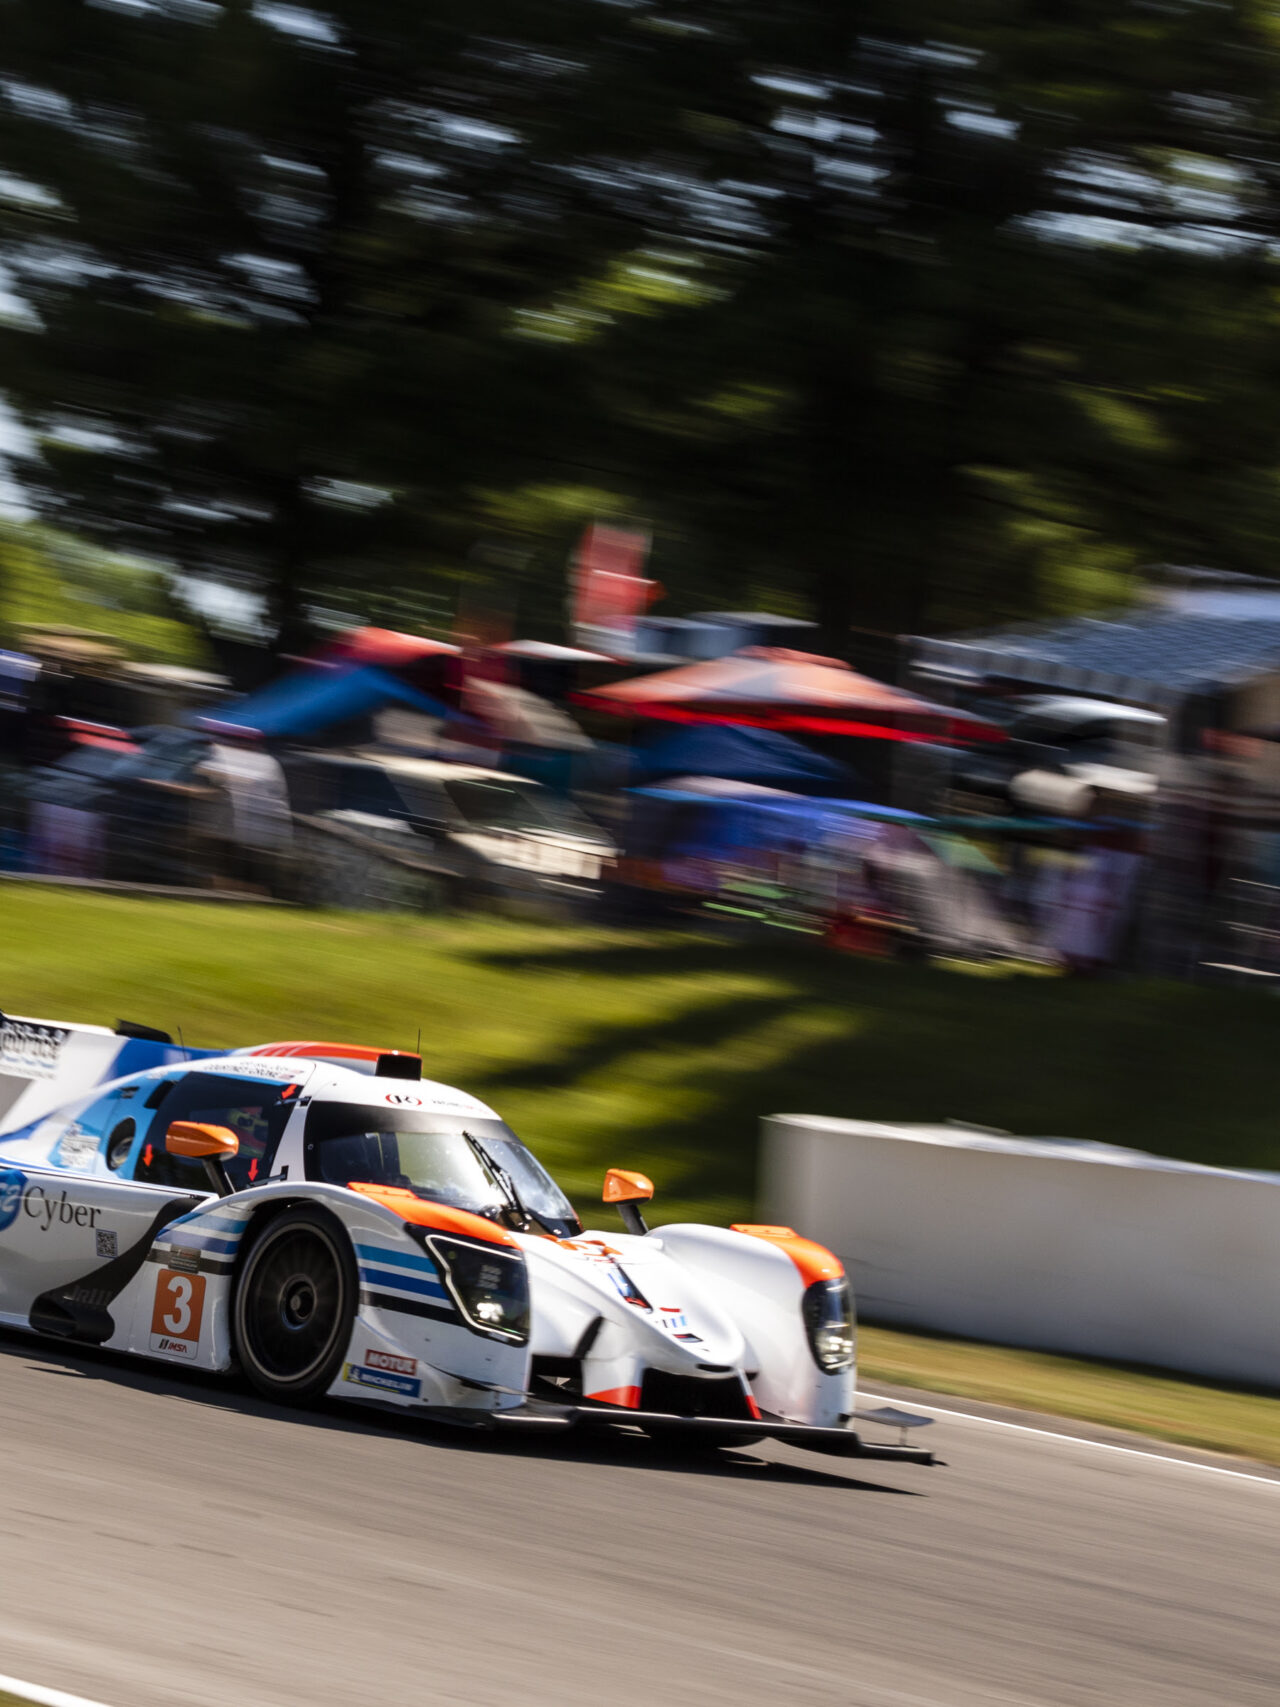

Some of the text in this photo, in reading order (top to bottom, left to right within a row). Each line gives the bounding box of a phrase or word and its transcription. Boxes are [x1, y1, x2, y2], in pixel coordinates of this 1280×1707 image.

[23, 1186, 102, 1232] Cyber
[163, 1275, 193, 1334] 3
[167, 1342, 188, 1354] IMSA
[366, 1352, 414, 1373] MOTUL
[361, 1373, 414, 1391] MICHELIN
